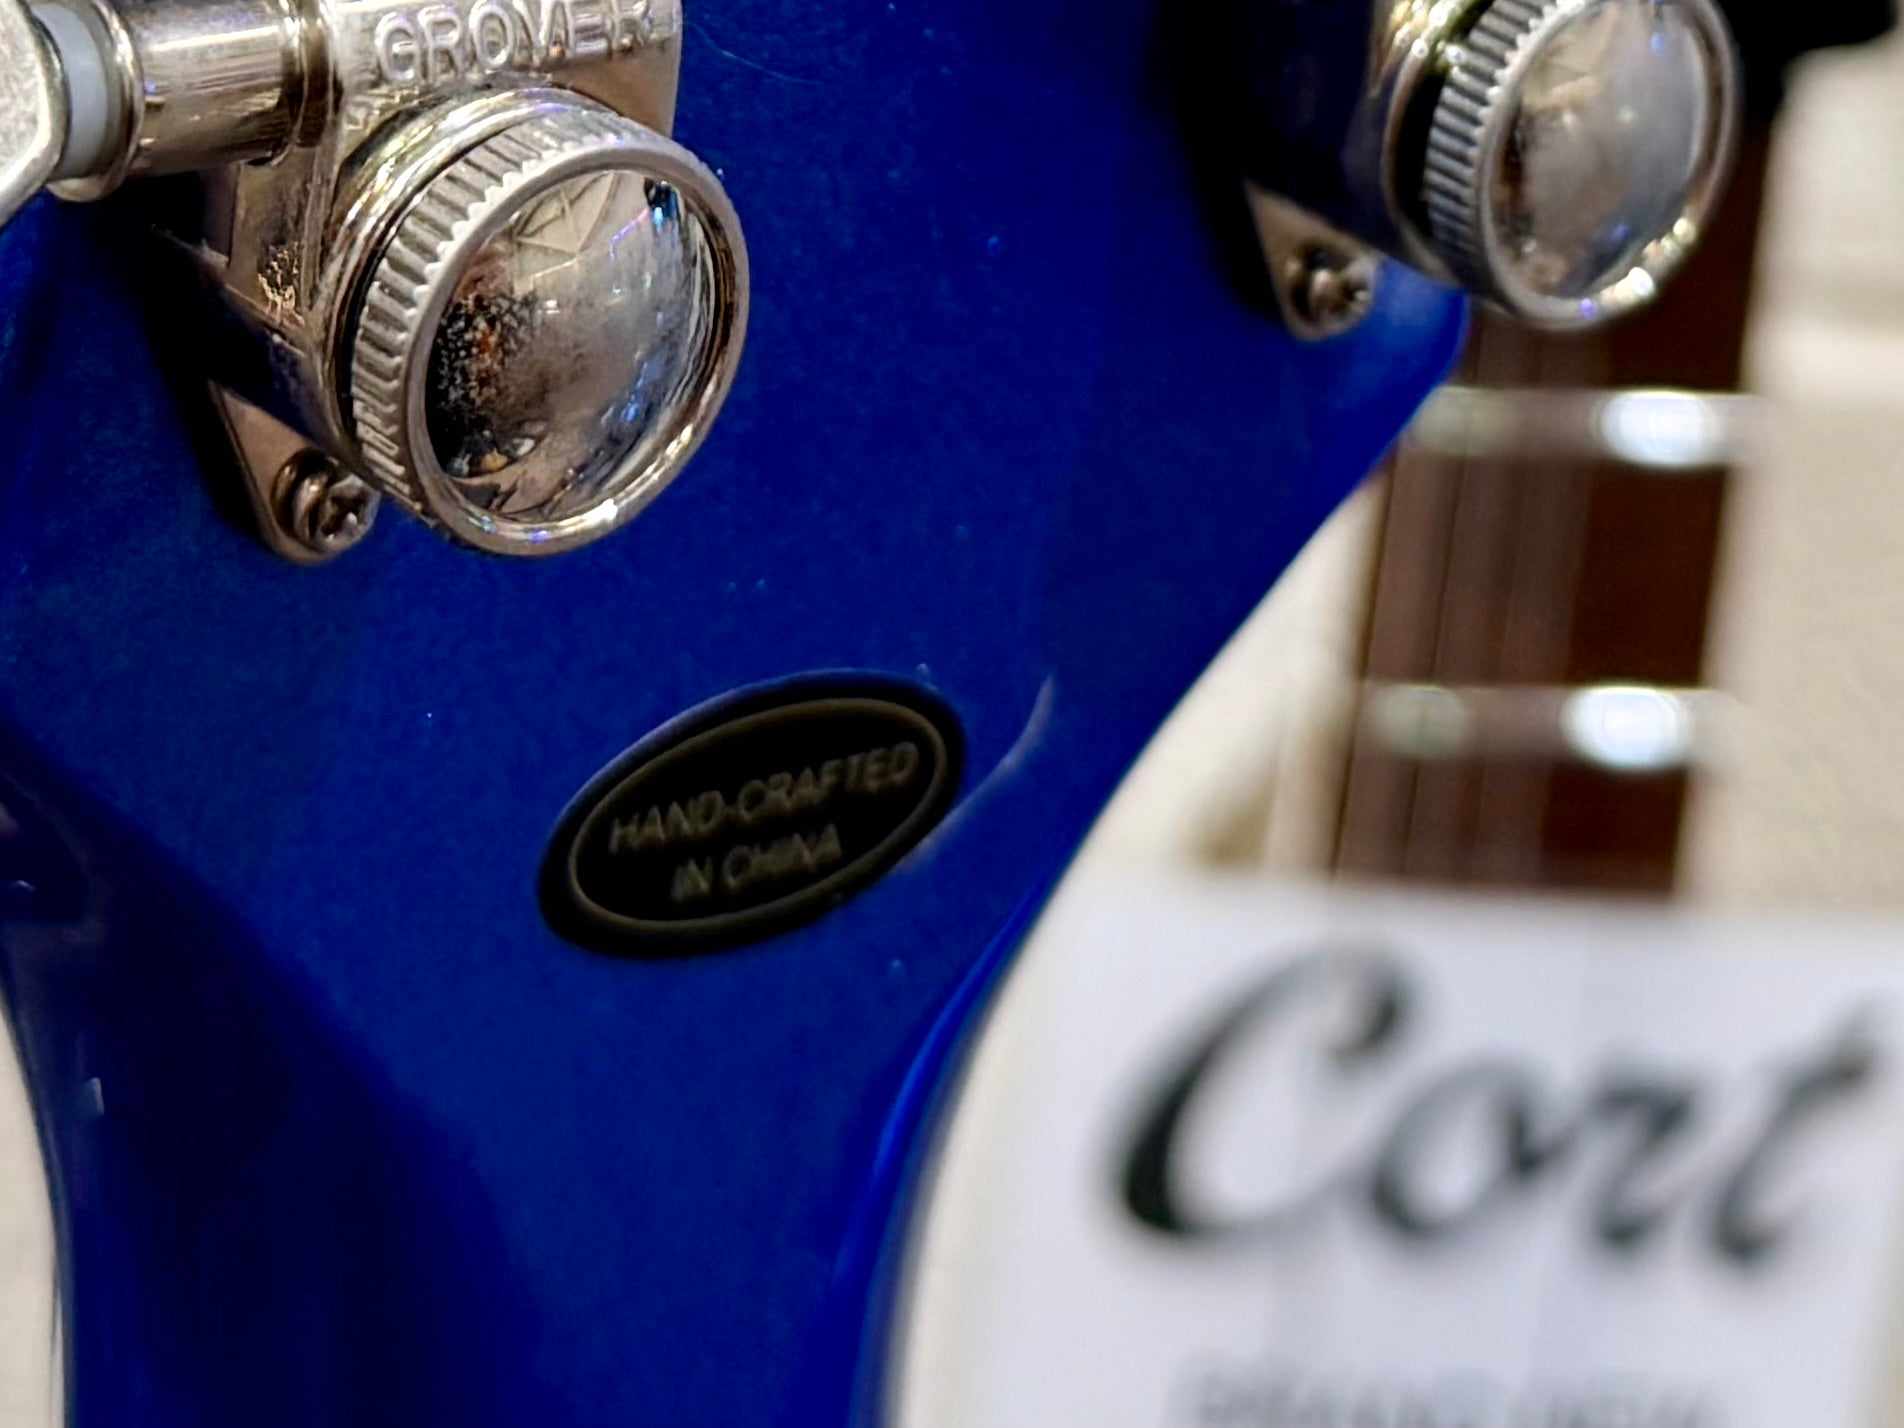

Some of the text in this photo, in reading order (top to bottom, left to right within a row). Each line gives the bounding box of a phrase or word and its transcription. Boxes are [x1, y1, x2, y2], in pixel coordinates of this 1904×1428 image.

[608, 742, 919, 854] HAND-CRAFTED
[671, 824, 842, 903] IN CHINA
[1111, 942, 1886, 1266] Cort
